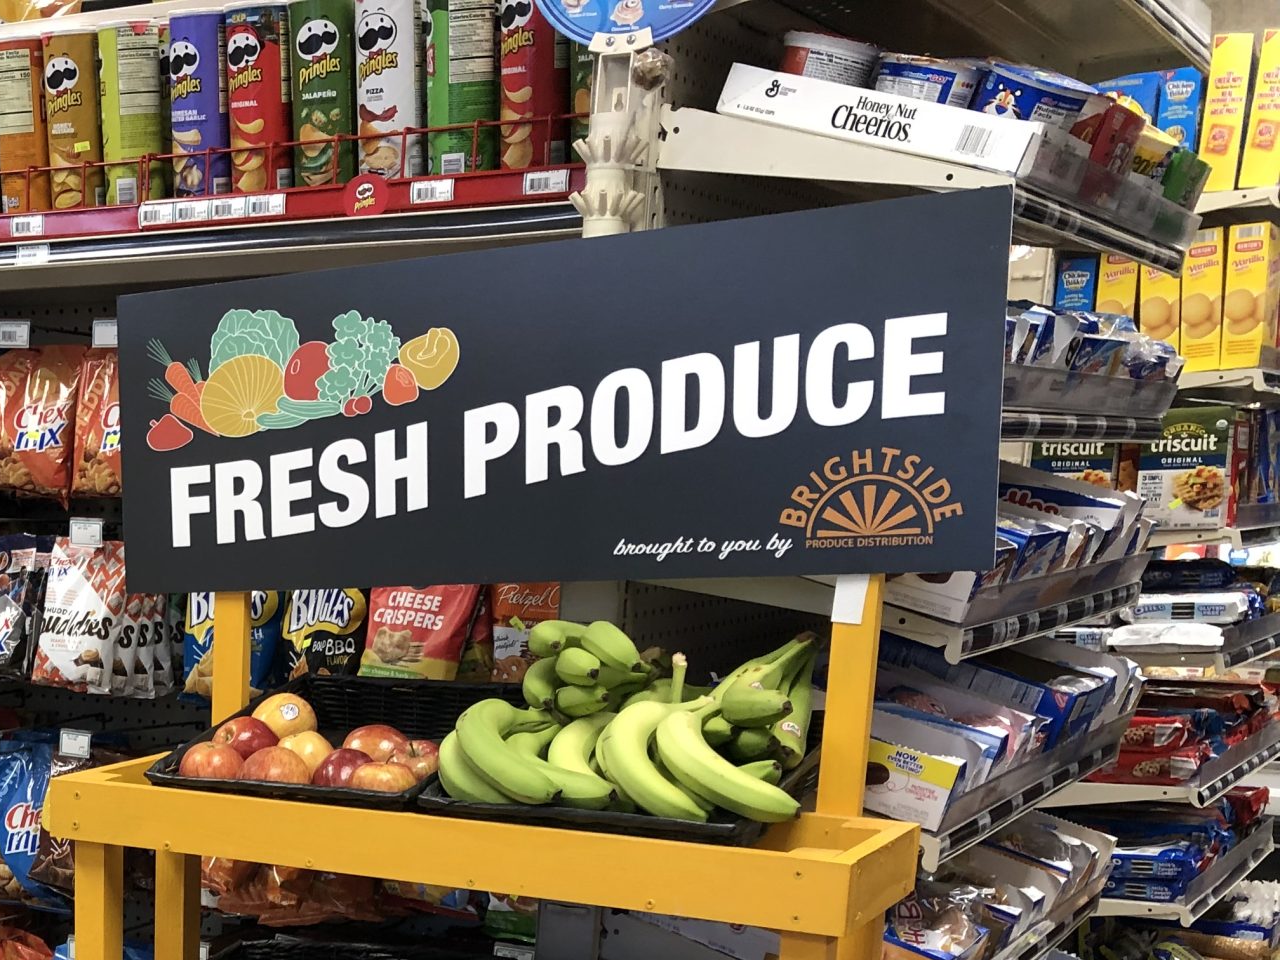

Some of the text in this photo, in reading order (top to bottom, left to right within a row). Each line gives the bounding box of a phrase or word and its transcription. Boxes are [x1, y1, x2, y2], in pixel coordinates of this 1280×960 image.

[232, 13, 247, 23] EXP
[299, 56, 341, 88] Pringles
[358, 50, 398, 79] Pringles
[229, 66, 262, 91] Pringles
[301, 89, 337, 100] JALAPEÑO
[366, 87, 384, 95] PIZZA
[47, 90, 82, 115] Pringles
[857, 96, 917, 120] Honey Nut
[831, 105, 911, 142] Cheerios
[1187, 259, 1220, 273] Vanilla
[1233, 255, 1265, 268] Vanilla
[1104, 266, 1135, 279] Vanilla
[15, 402, 68, 430] Chex
[170, 312, 948, 548] FRESH PRODUCE
[1164, 422, 1206, 437] ORGANIC
[1041, 442, 1104, 456] triscuit
[1151, 433, 1218, 452] triscuit
[779, 447, 964, 528] BRIGHTSIDE
[613, 532, 793, 561] brought to you by
[806, 535, 933, 549] PRODUCE DISTRIBUTION
[388, 591, 442, 611] CHEESE
[498, 583, 545, 607] Pretzel
[289, 589, 354, 633] BUGLES
[374, 609, 445, 630] CRISPERS
[326, 638, 355, 655] BBQ
[326, 655, 349, 666] FLAVOR
[896, 751, 919, 762] NOW
[902, 757, 923, 769] BETTER
